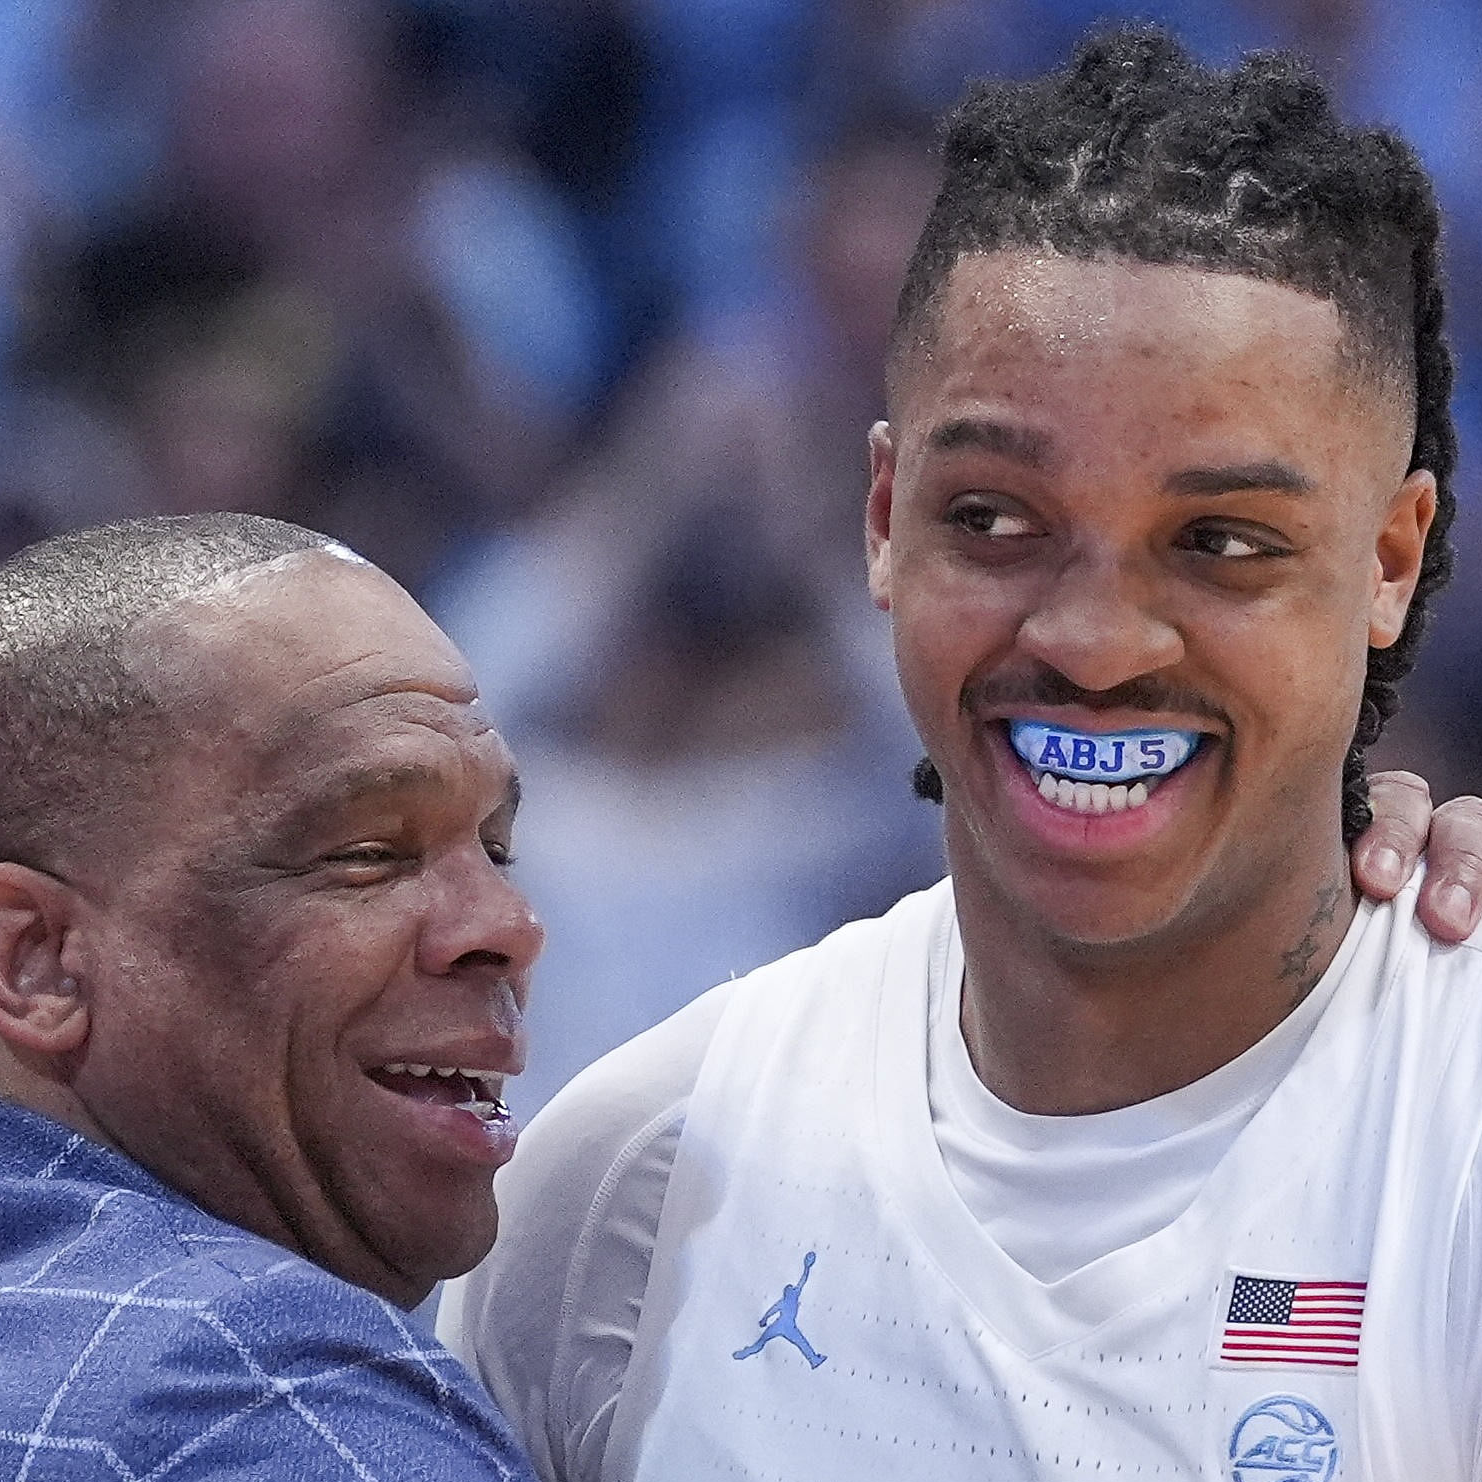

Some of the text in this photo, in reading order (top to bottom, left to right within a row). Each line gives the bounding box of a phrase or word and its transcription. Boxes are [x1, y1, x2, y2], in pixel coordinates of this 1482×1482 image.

[1038, 734, 1167, 773] ABJ 5
[1241, 1434, 1335, 1465] ACC
